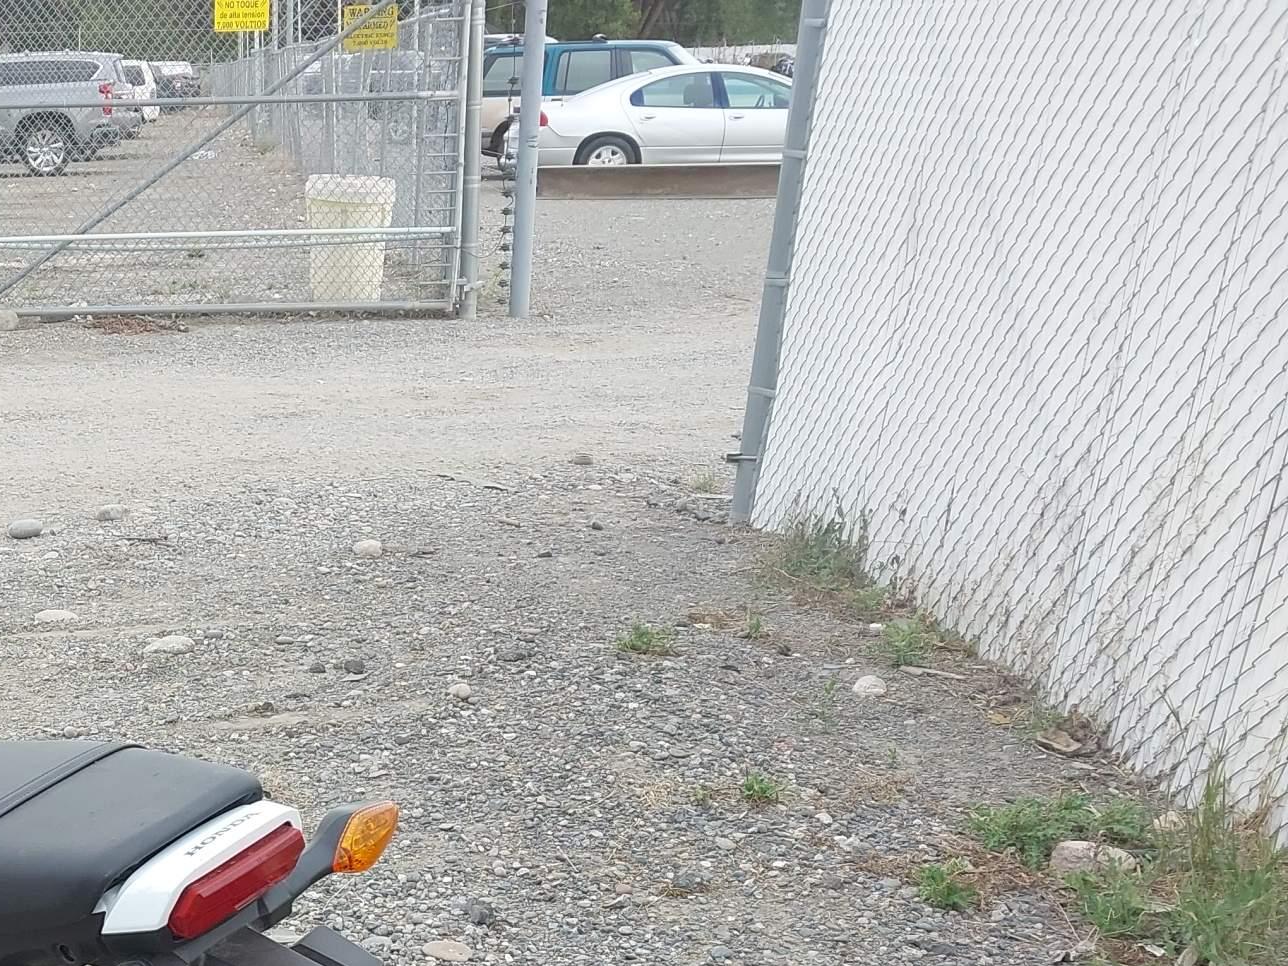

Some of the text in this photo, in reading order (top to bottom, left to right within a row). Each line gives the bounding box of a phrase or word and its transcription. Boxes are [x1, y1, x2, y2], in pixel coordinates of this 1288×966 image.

[224, 0, 234, 9] NO
[348, 6, 394, 18] WARING
[184, 811, 263, 857] HONDA
